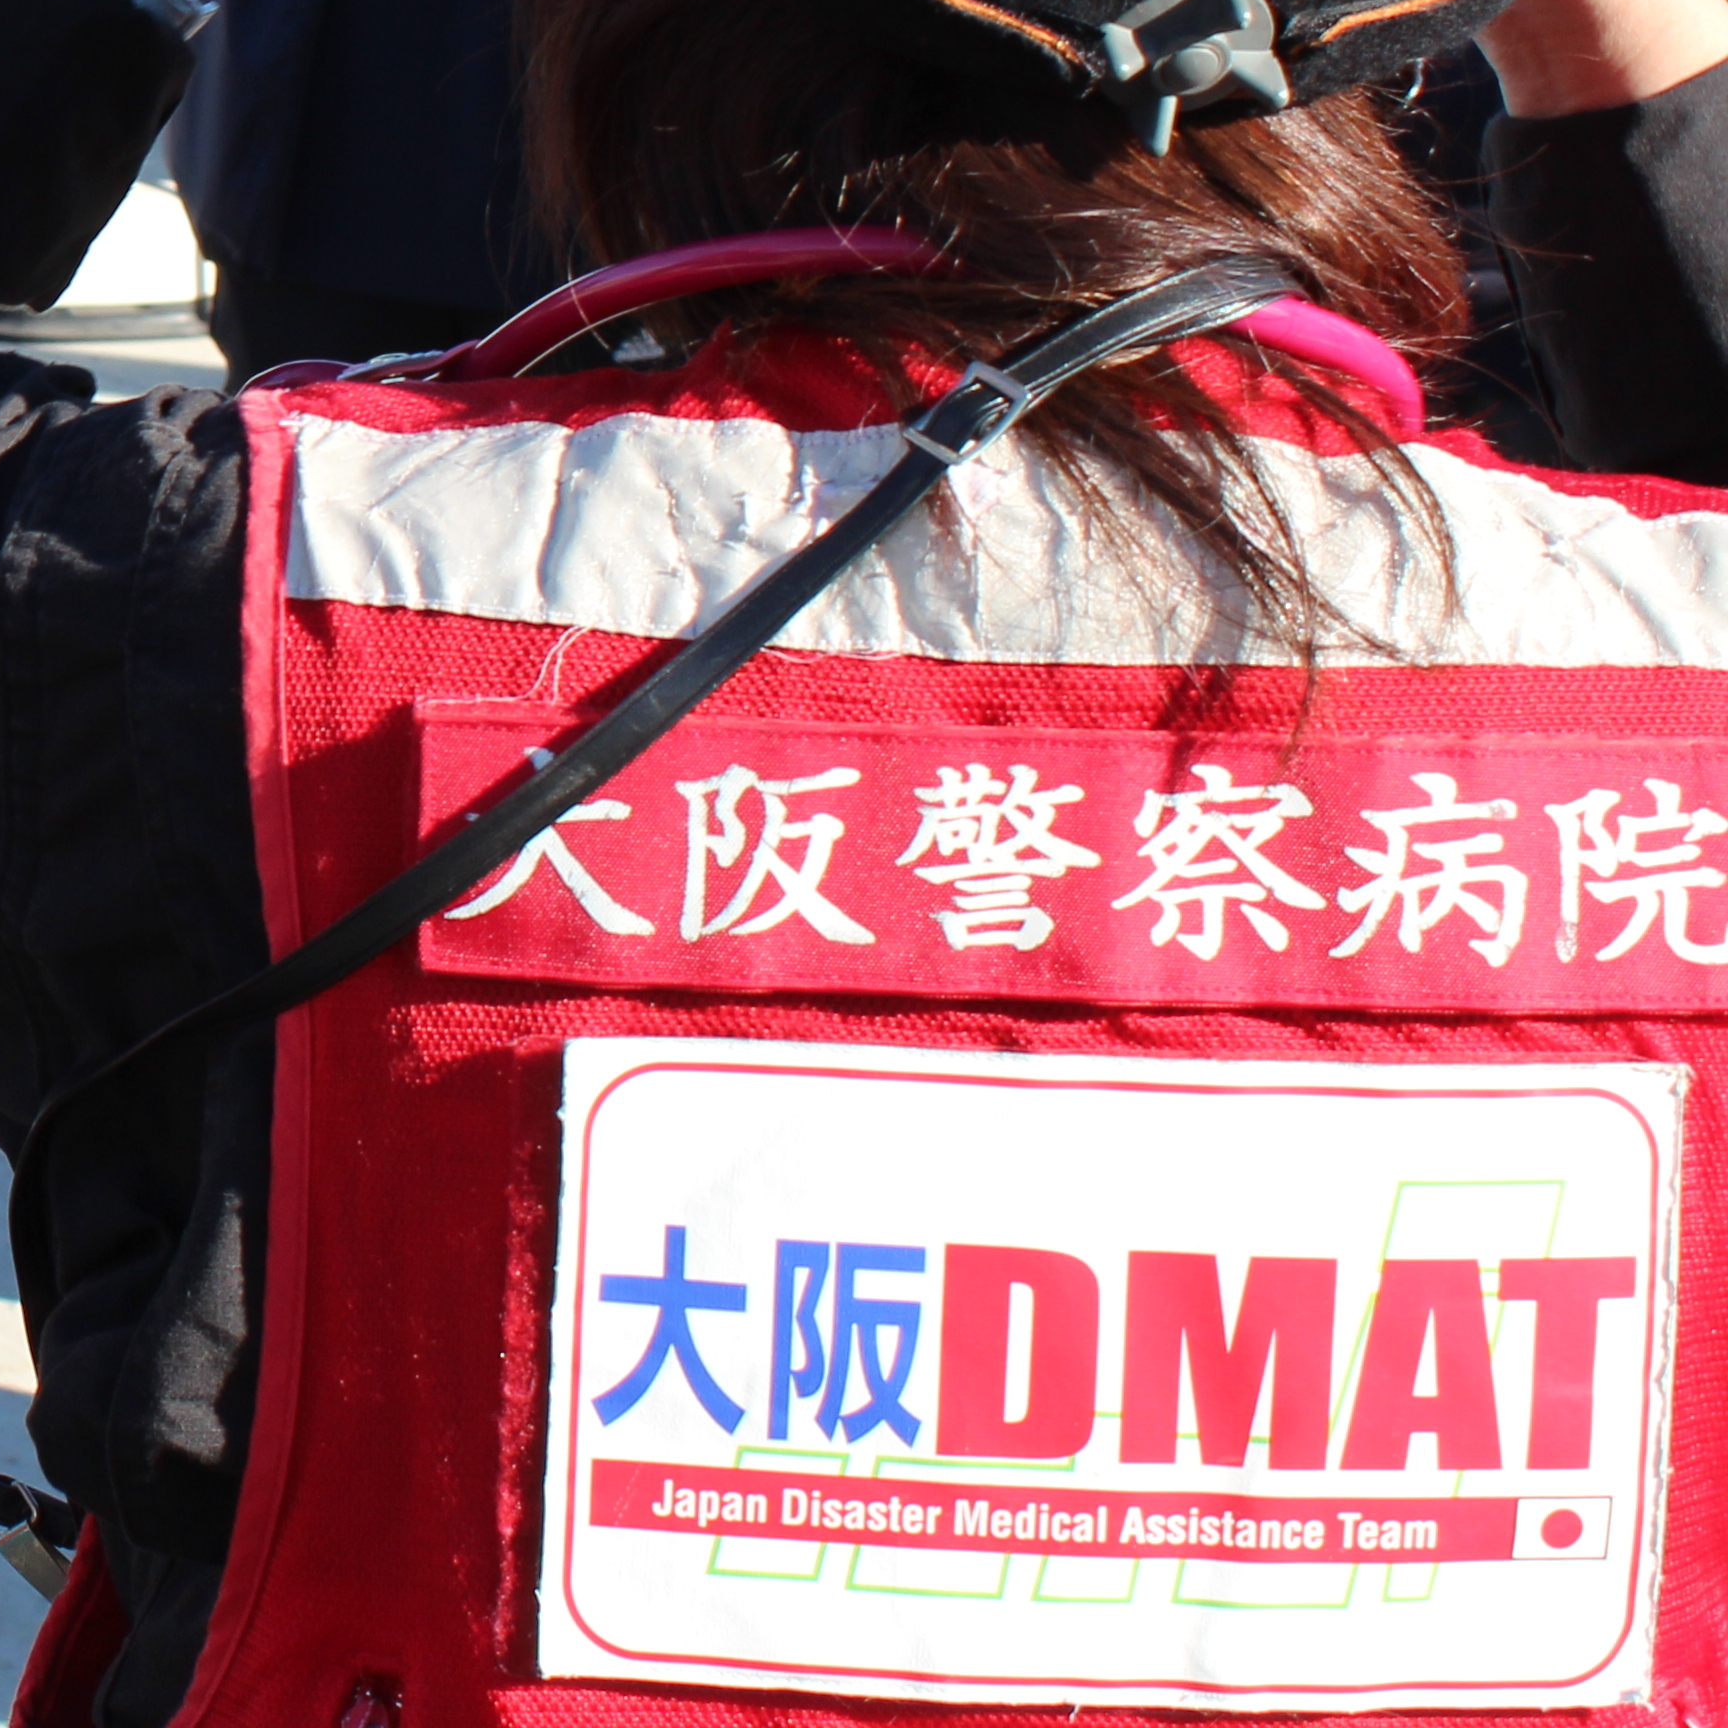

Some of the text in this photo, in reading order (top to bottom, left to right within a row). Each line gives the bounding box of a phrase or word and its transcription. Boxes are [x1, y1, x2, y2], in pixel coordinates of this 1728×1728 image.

[443, 746, 1728, 967] 大阪警察病院
[651, 1478, 1438, 1550] Japan Disaster Medical Assistance Team
